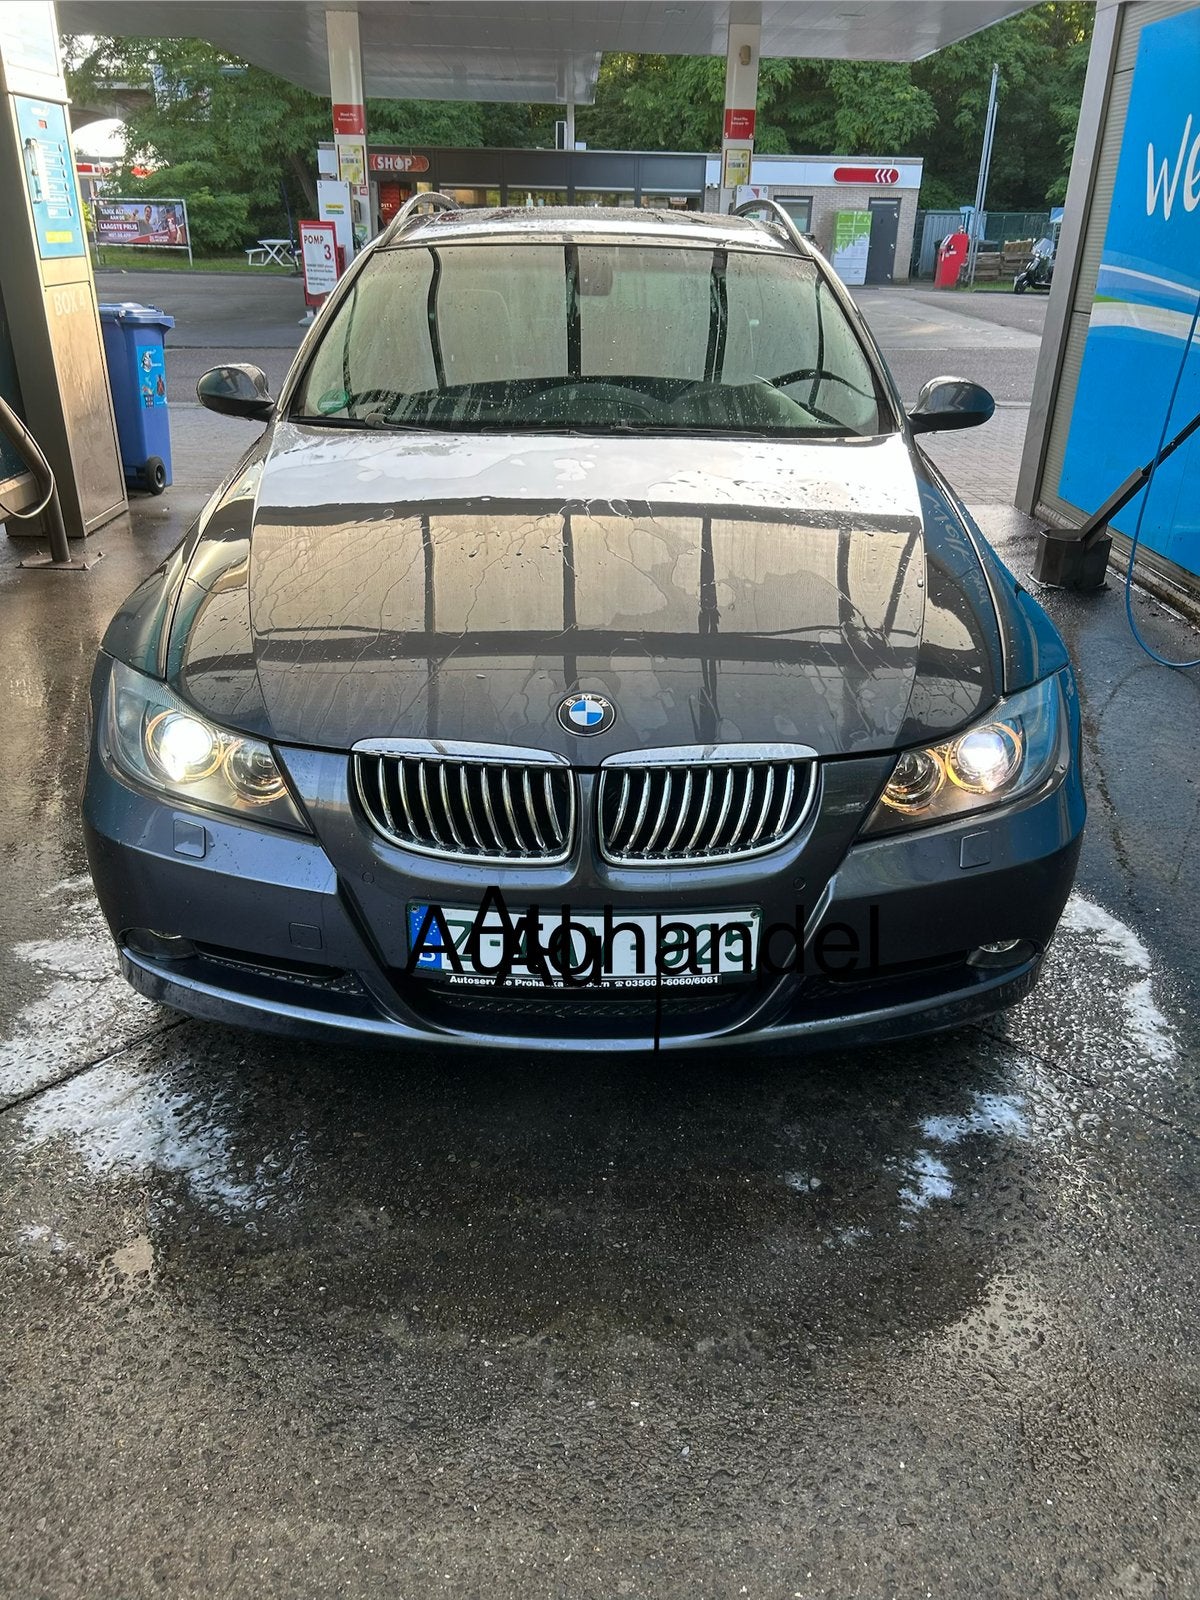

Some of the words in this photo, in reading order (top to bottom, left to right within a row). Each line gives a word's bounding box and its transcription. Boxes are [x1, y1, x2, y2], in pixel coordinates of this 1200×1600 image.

[377, 156, 412, 170] SHOP
[304, 235, 324, 244] POMP
[54, 290, 79, 316] BOX
[565, 694, 609, 707] BMW
[450, 975, 512, 986] Autoserve
[515, 979, 564, 988] Prohaka
[625, 976, 718, 987] 03560-6060/6061
